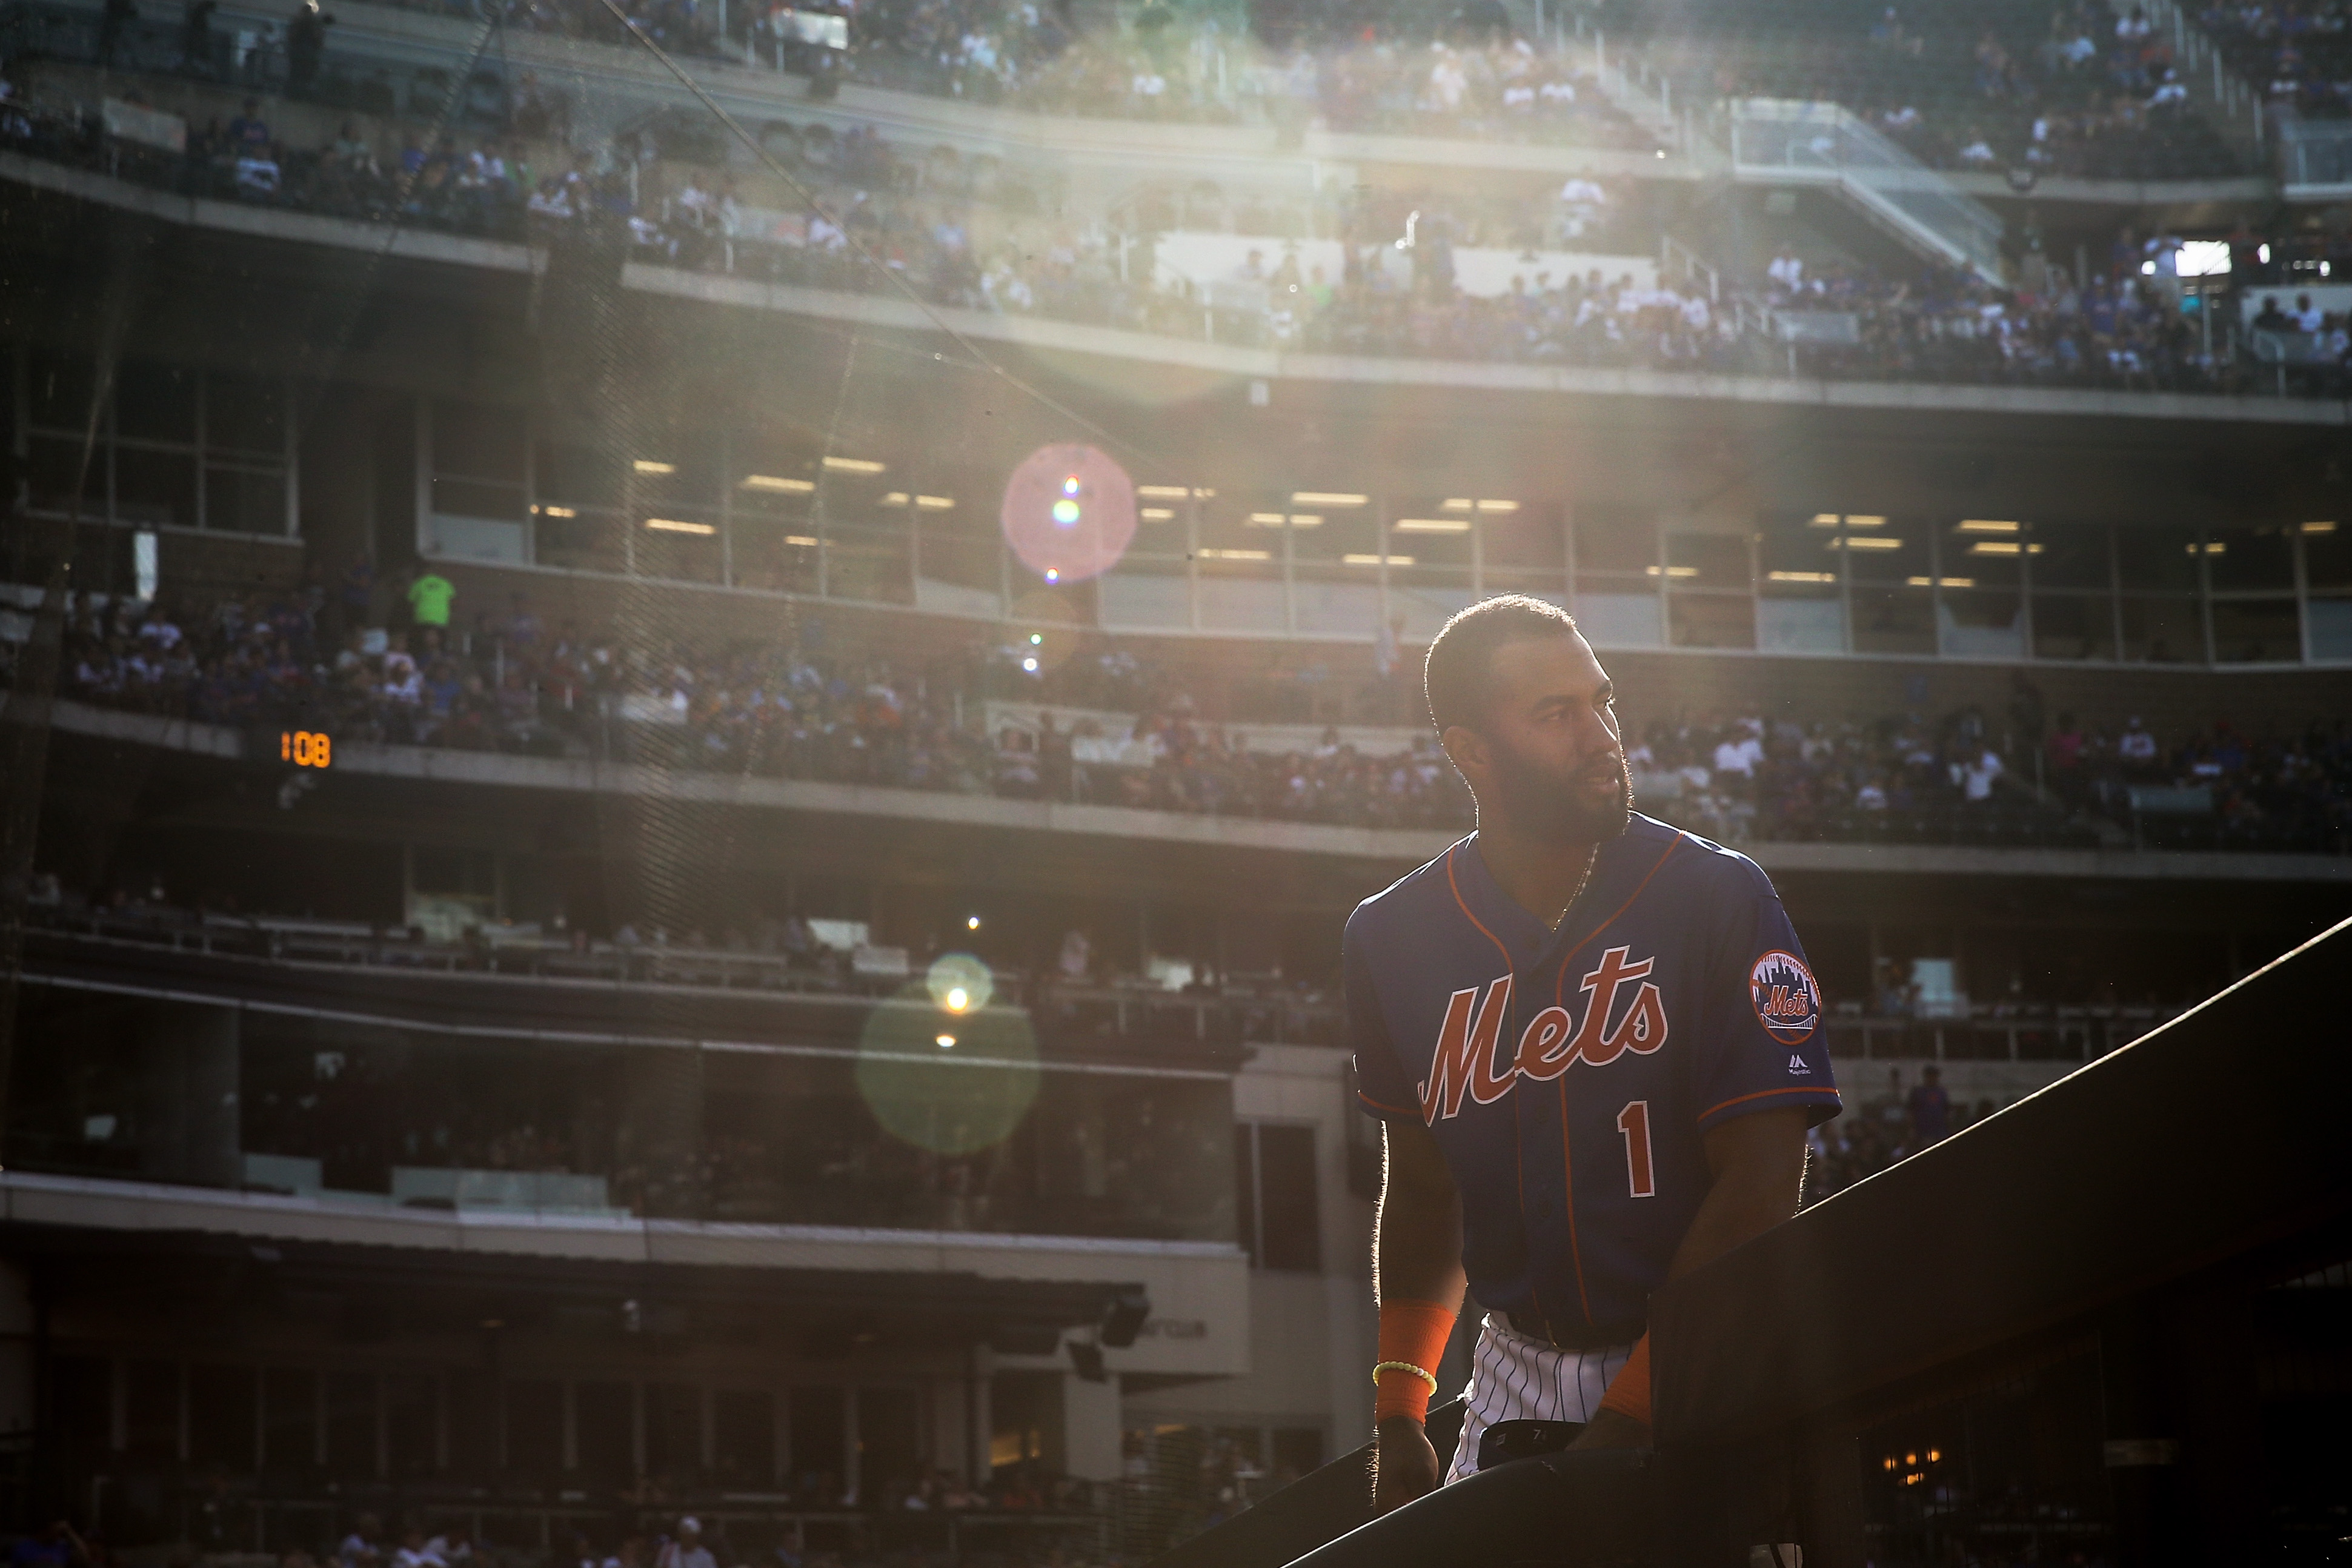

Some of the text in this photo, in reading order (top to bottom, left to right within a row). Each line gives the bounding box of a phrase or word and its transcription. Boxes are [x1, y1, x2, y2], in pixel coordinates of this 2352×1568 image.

[281, 731, 331, 768] 108
[1764, 985, 1809, 1016] Mets
[1418, 945, 1668, 1127] Mets
[1617, 1101, 1655, 1197] 1
